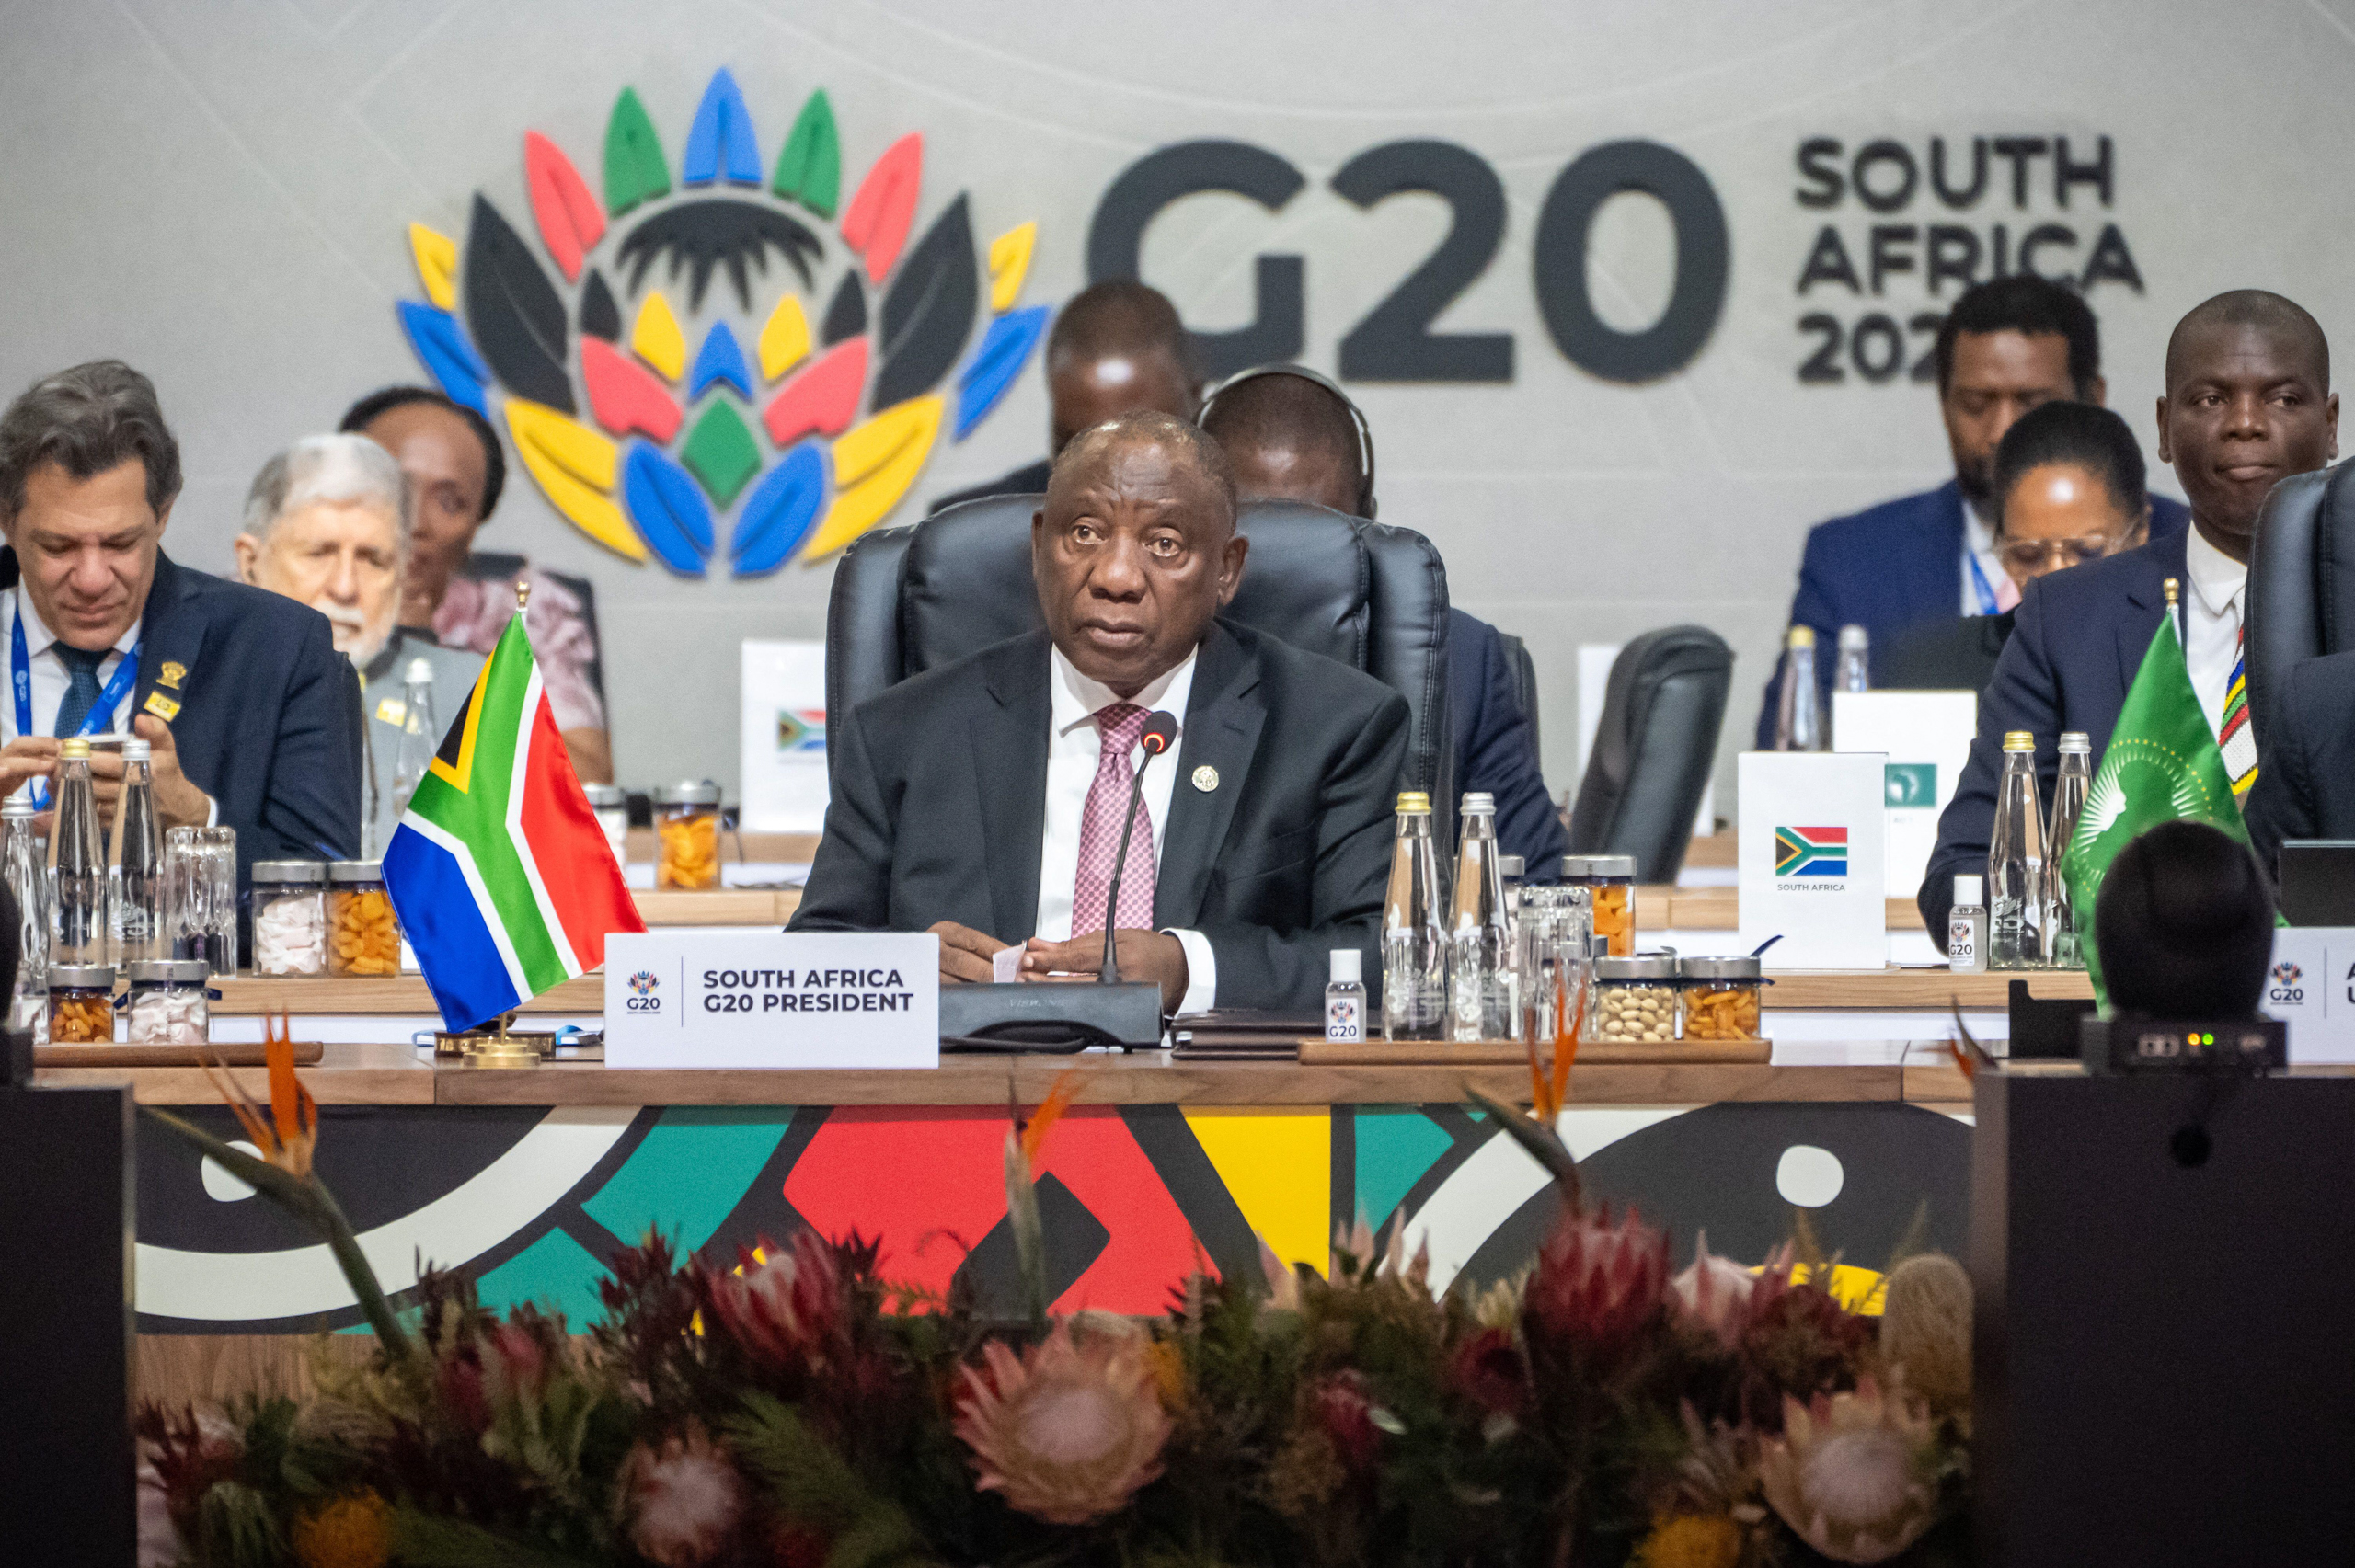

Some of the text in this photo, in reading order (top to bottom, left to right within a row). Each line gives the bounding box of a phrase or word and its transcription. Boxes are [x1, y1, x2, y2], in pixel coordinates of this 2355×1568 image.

[1796, 135, 2114, 212] SOUTH
[1086, 139, 1731, 385] G20
[1796, 223, 2146, 297] AFRICA
[1797, 312, 1940, 383] 202
[1950, 944, 1973, 956] G20
[703, 968, 904, 989] SOUTH AFRICA
[626, 997, 661, 1010] G20
[703, 993, 914, 1013] G20 PRESIDENT
[2270, 988, 2303, 1001] G20
[1329, 1025, 1357, 1037] G20
